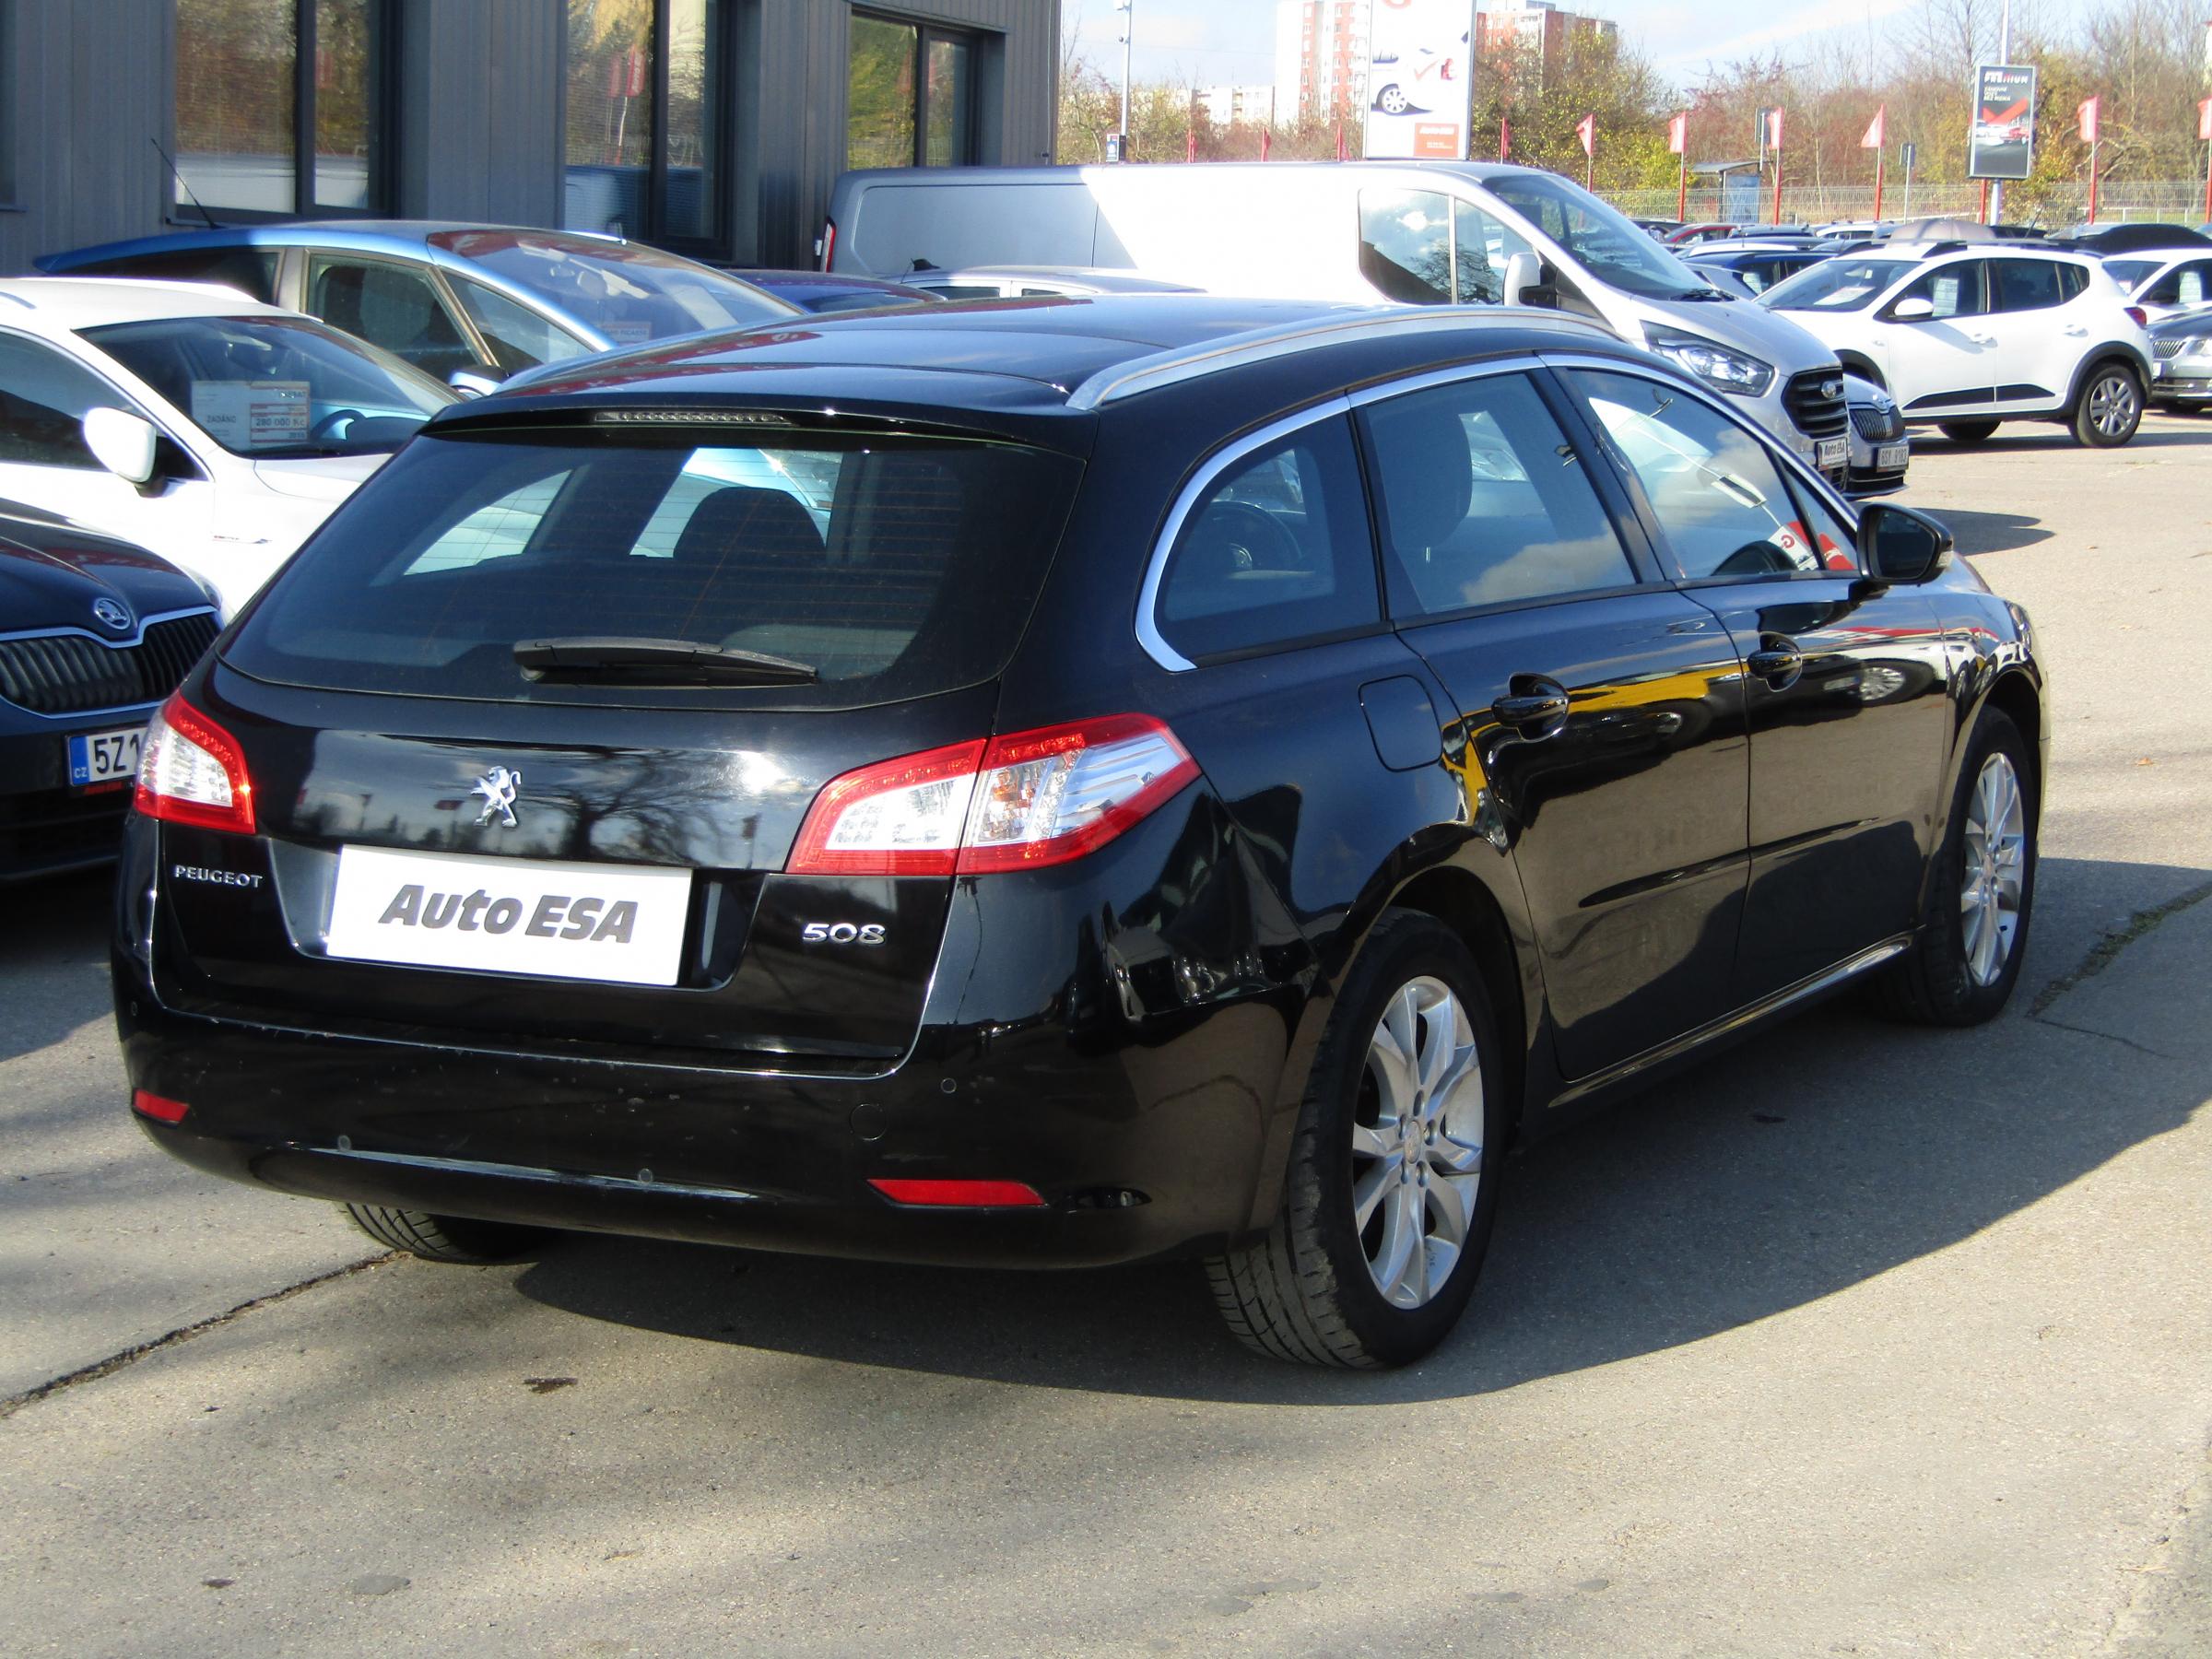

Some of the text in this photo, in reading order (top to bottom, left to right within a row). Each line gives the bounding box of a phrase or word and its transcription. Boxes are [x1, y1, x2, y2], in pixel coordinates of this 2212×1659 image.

[275, 418, 291, 426] 000
[75, 767, 87, 779] CZ
[175, 865, 264, 888] PEUGEOT
[378, 884, 639, 944] Auto ESA
[803, 923, 886, 944] 508
